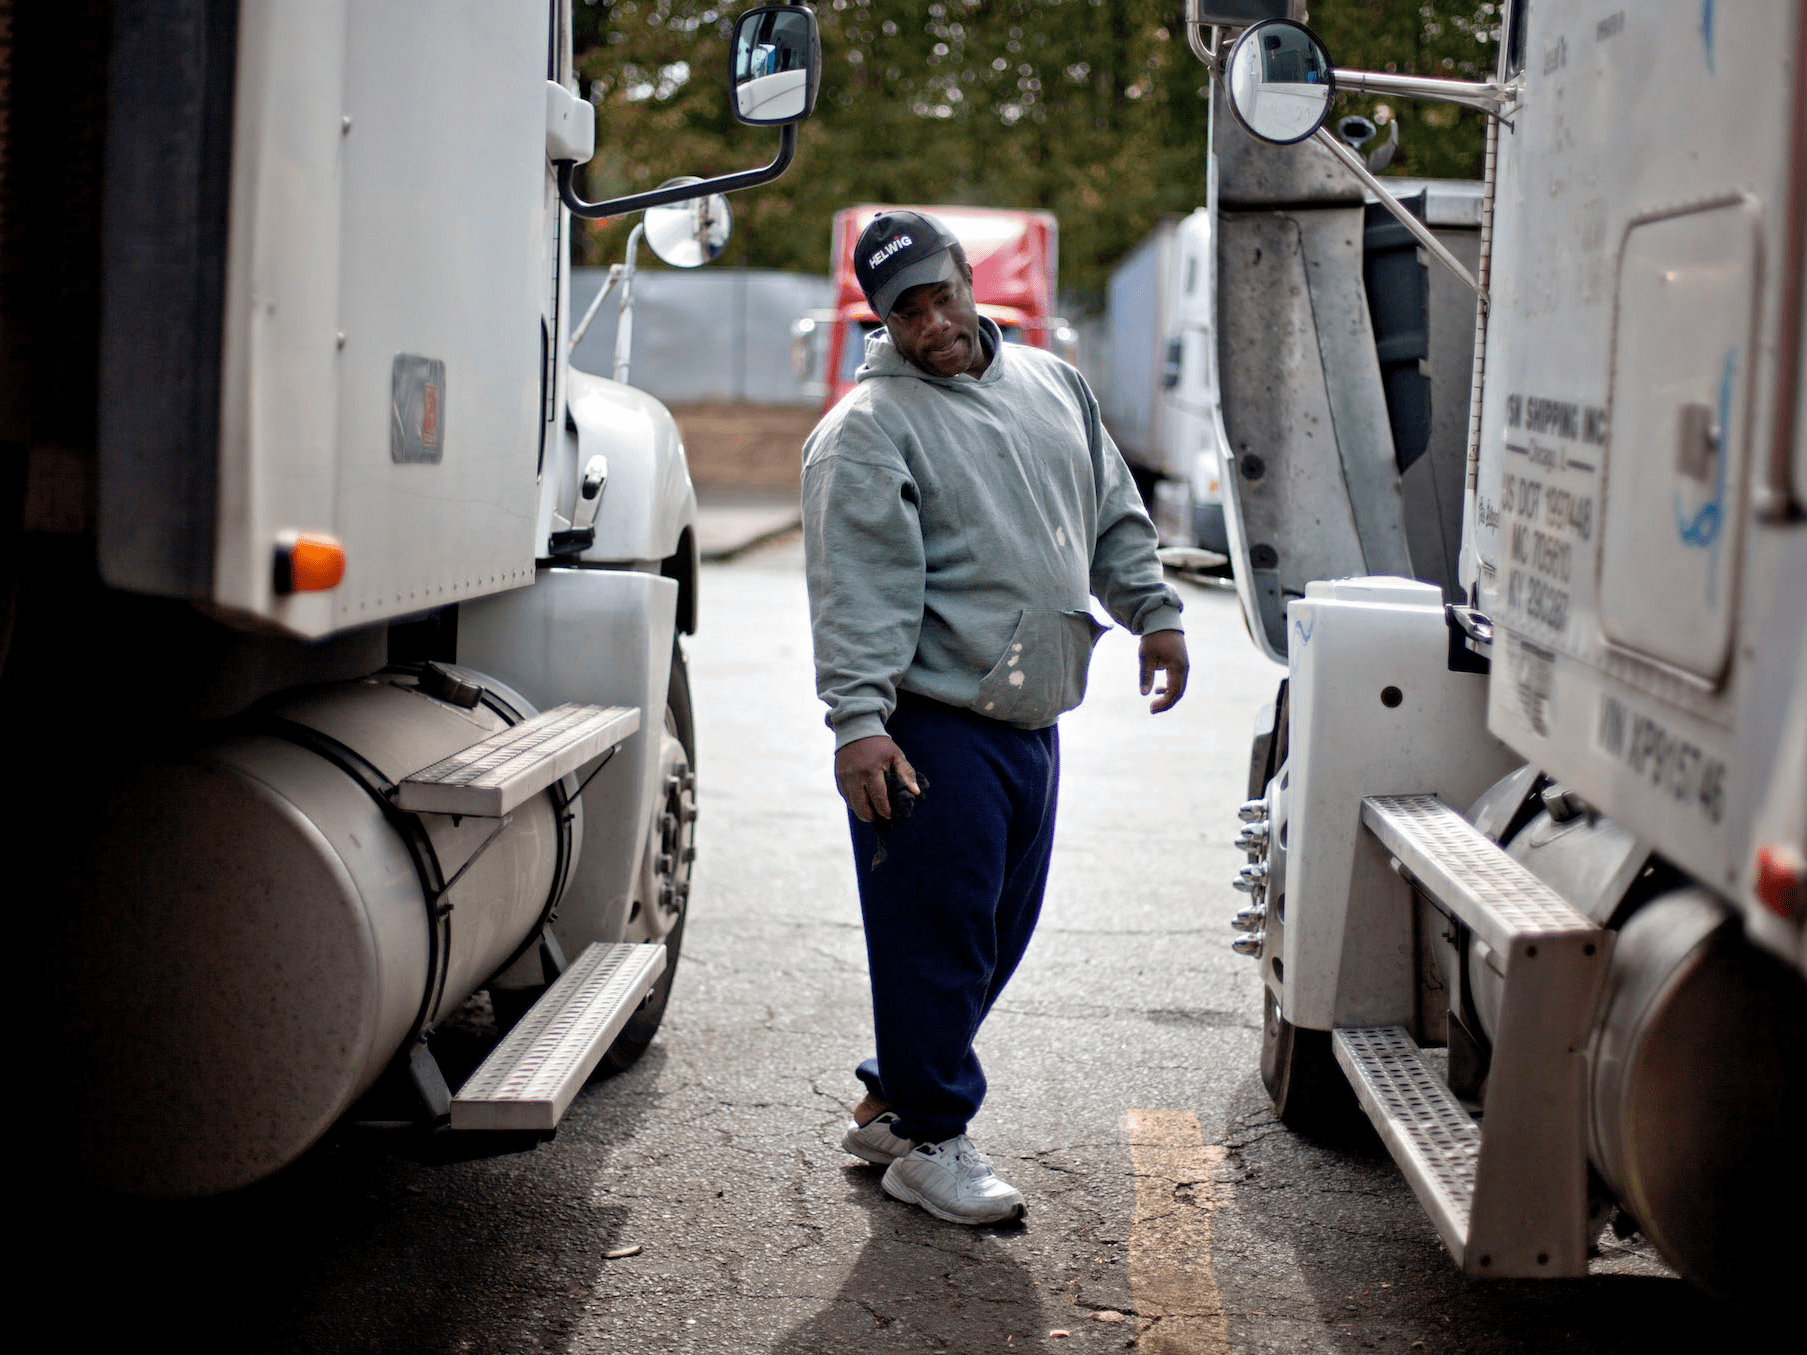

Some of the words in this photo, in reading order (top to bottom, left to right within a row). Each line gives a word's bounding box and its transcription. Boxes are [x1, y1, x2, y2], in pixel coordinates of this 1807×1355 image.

[868, 236, 913, 270] HELWIG
[1526, 395, 1578, 442] SHIPPING
[1518, 478, 1542, 520] DOT
